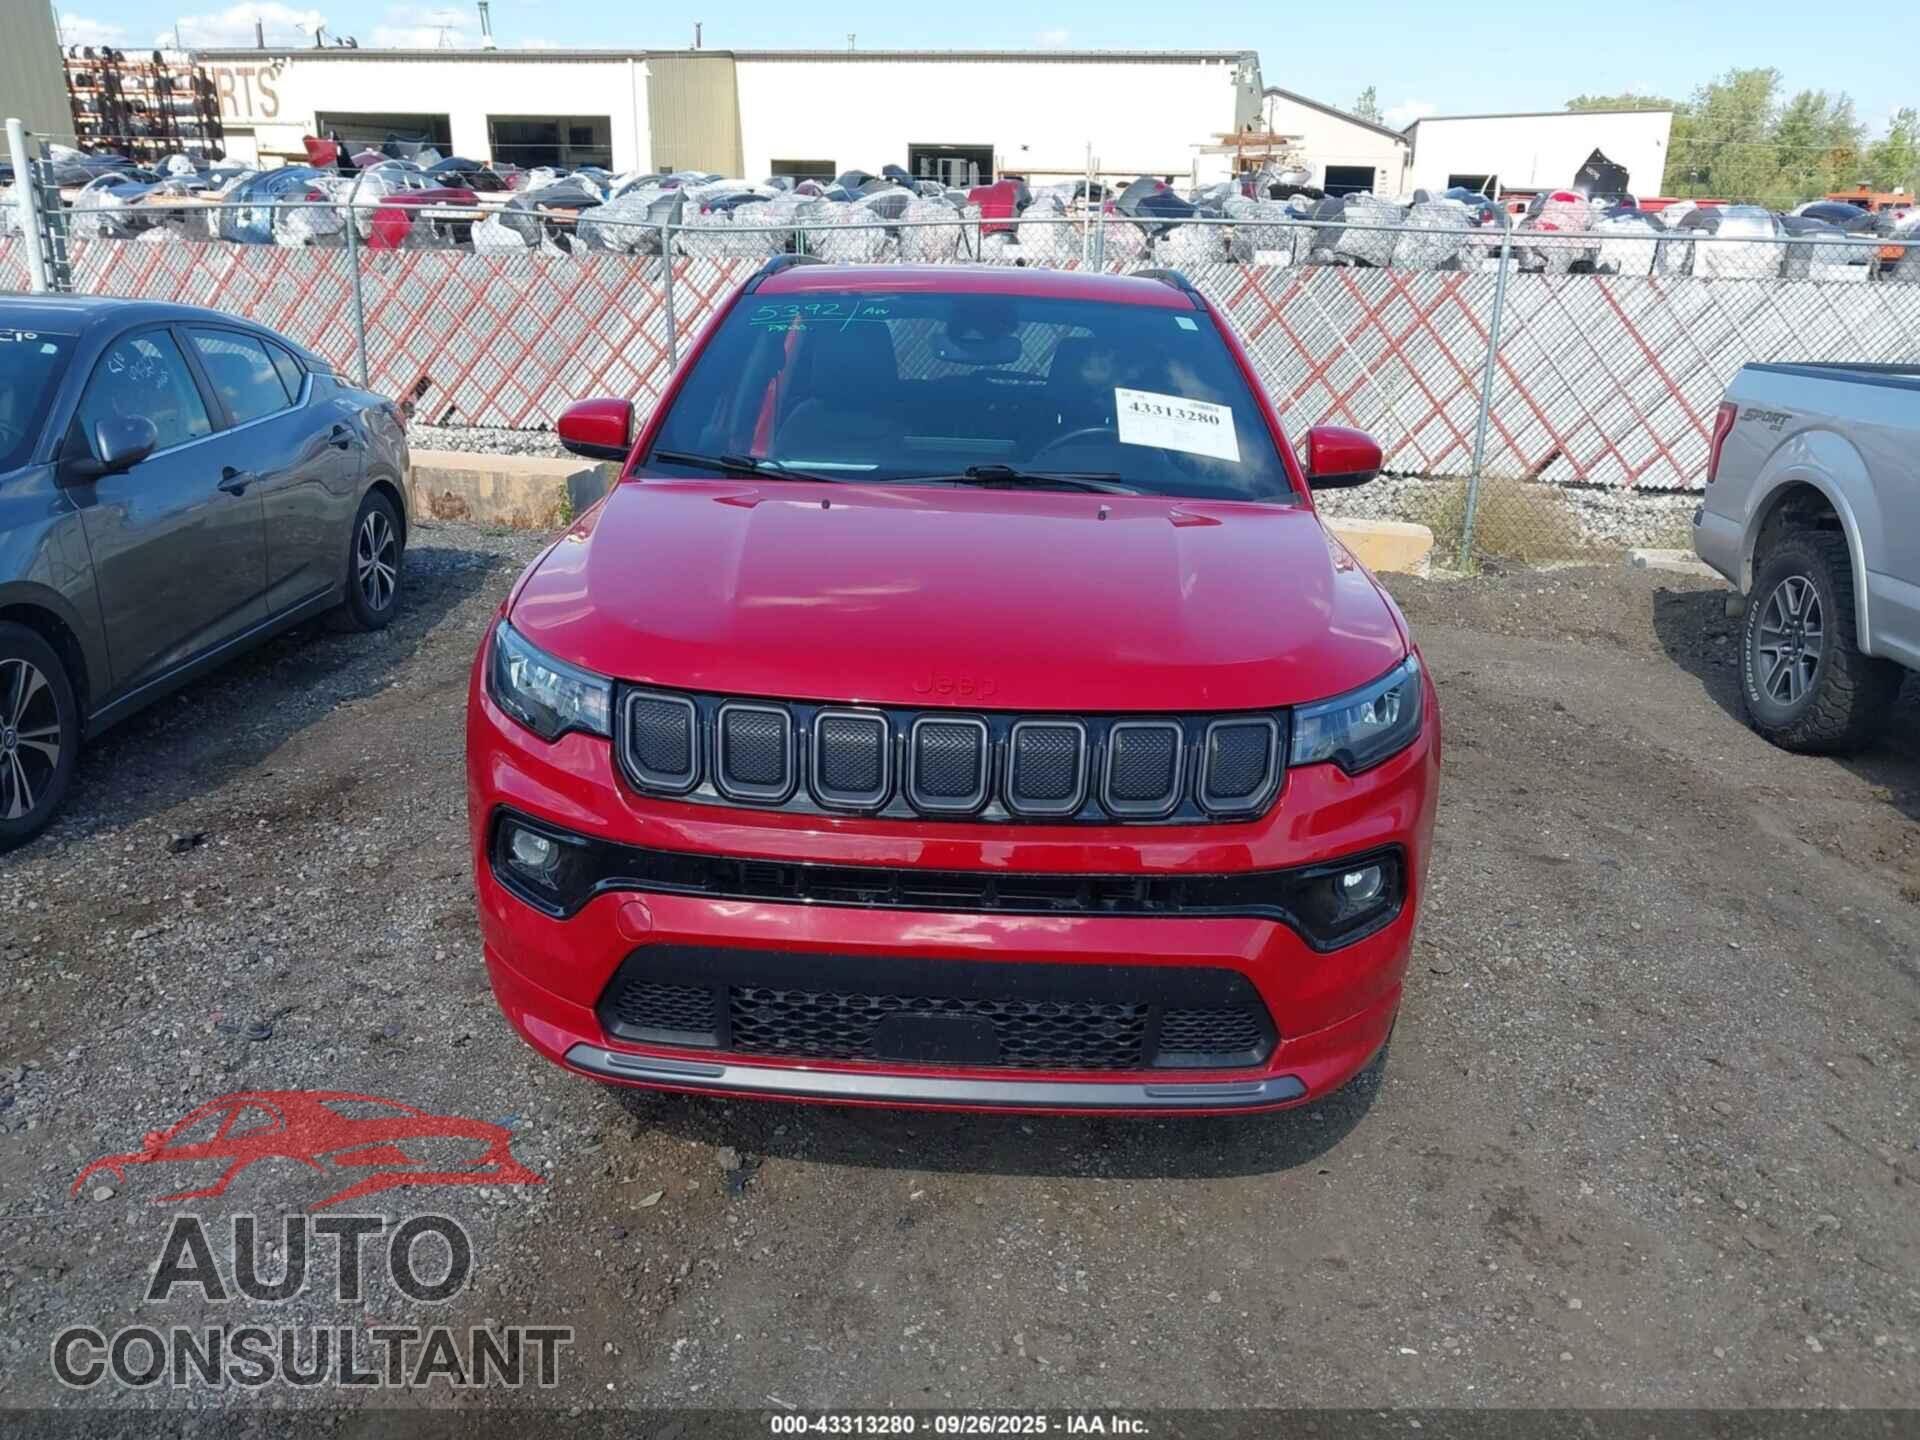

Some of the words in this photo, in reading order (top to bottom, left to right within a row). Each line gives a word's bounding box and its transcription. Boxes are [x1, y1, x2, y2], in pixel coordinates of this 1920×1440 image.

[1128, 401, 1221, 426] 43313280
[1739, 407, 1793, 426] SPORT
[911, 671, 999, 701] Jeep
